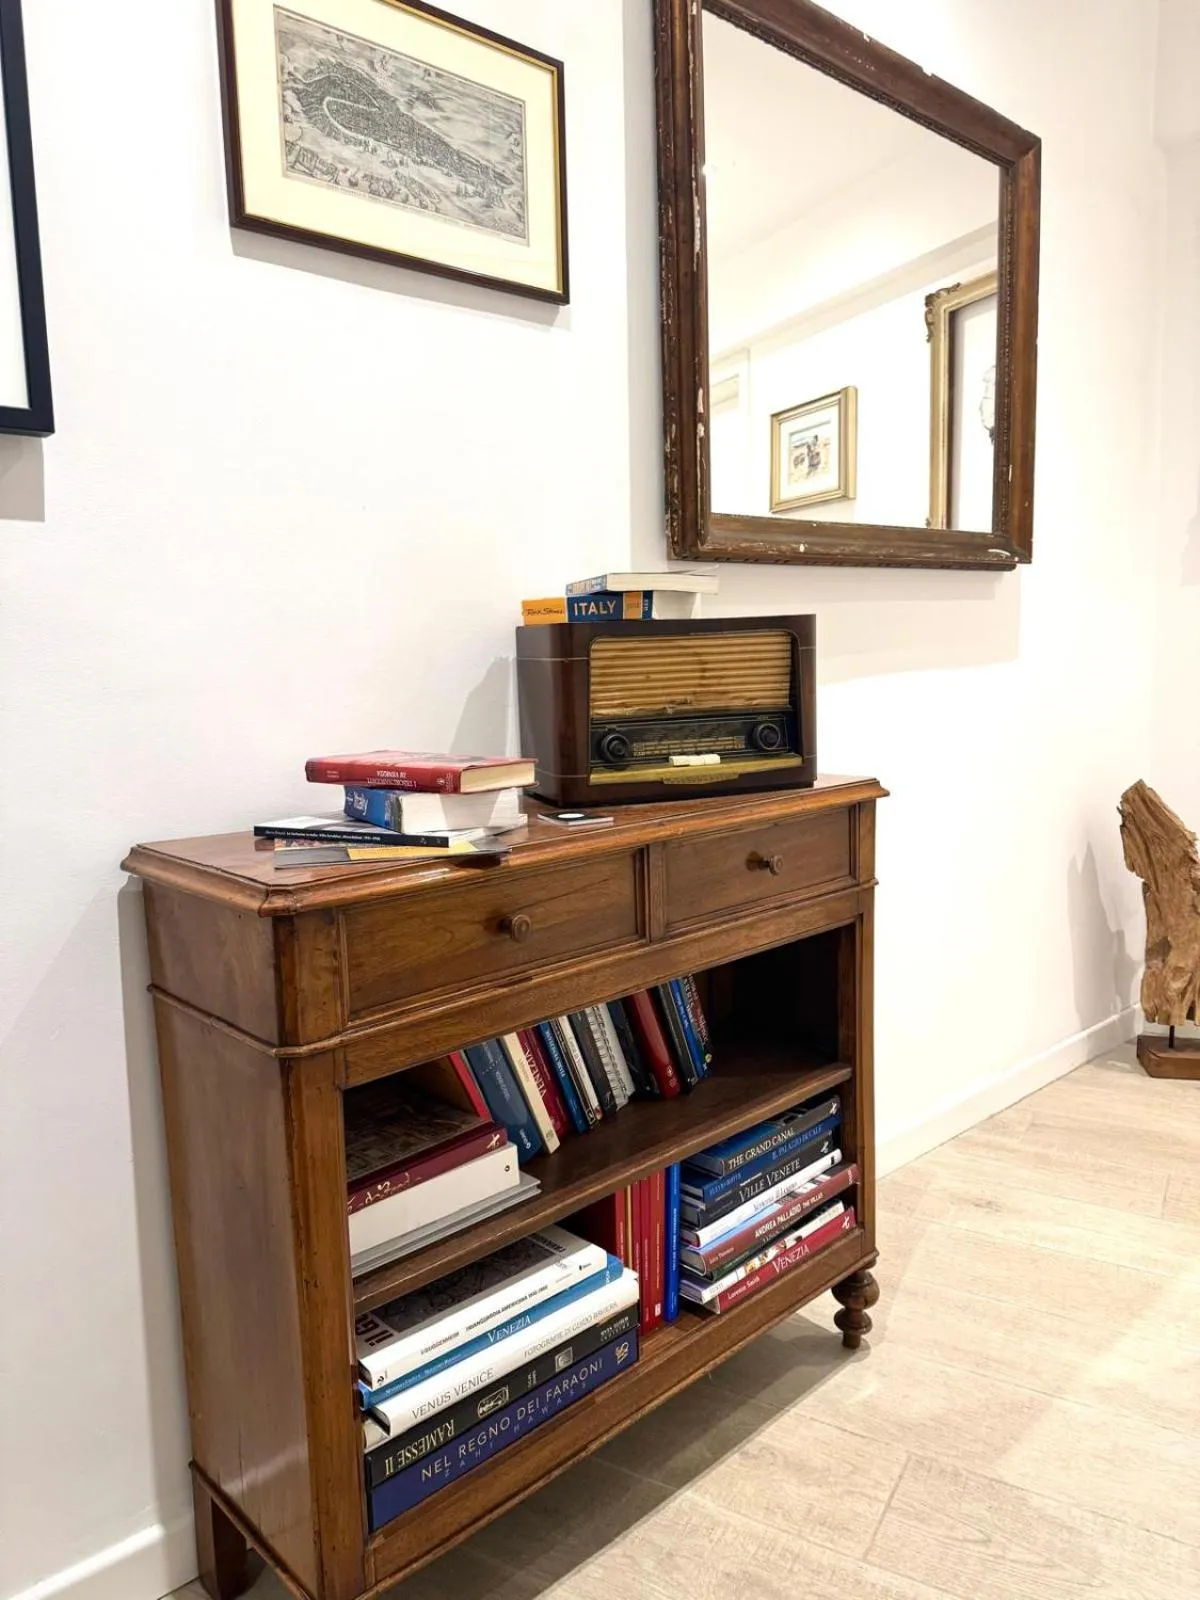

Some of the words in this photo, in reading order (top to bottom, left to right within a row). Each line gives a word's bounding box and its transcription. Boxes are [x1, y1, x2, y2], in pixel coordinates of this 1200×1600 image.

[573, 600, 616, 616] ITALY
[728, 1153, 744, 1170] THE
[745, 1140, 771, 1160] GRAND
[771, 1128, 794, 1146] CANAL
[740, 1179, 764, 1202] VILLE
[766, 1158, 800, 1187] VENETE
[755, 1221, 777, 1238] ANDREA
[777, 1204, 802, 1223] PALLADIO
[772, 1244, 811, 1274] VENEZIA
[488, 1315, 531, 1342] VENEZIA
[412, 1391, 451, 1419] VENUS
[454, 1367, 494, 1397] VENICE
[421, 1455, 451, 1482] NEL
[458, 1416, 510, 1458] REGNO
[517, 1397, 540, 1420] DEI
[546, 1358, 603, 1402] FARAONI
[397, 1419, 455, 1469] RAMESSE
[385, 1456, 393, 1476] II
